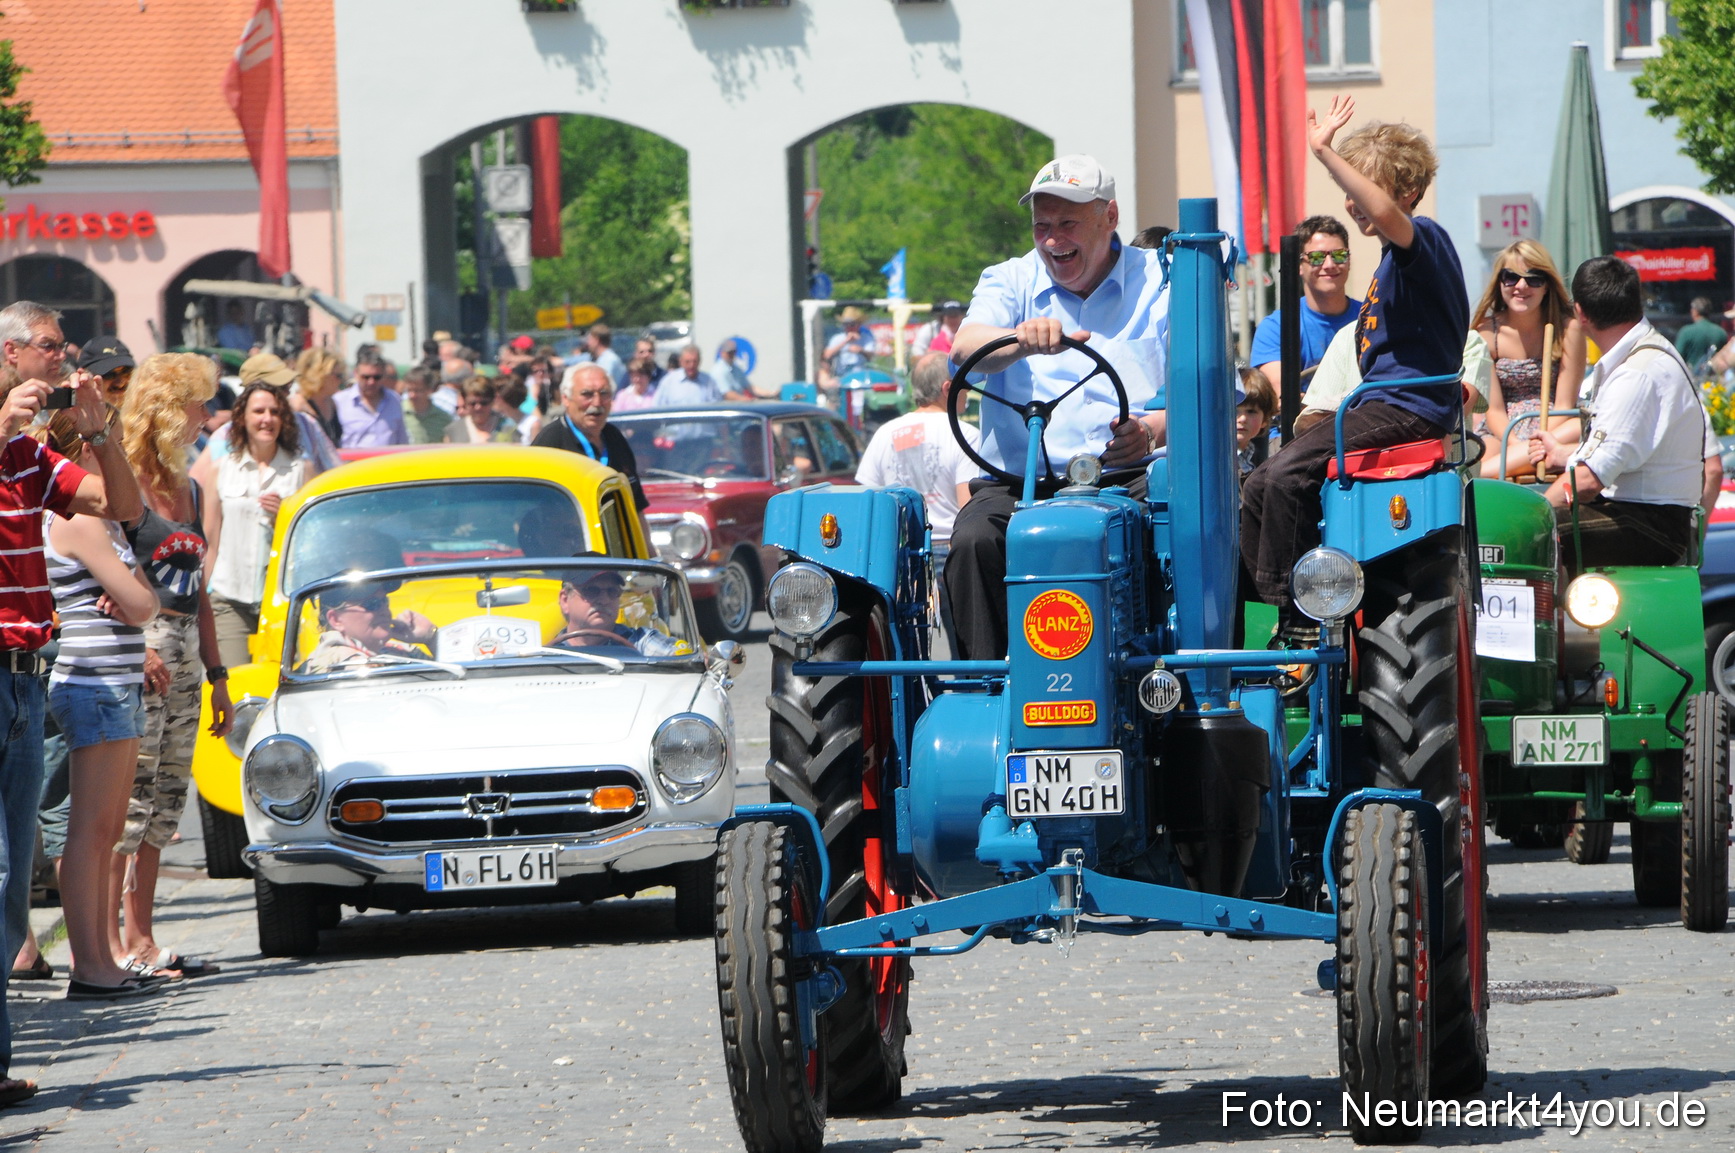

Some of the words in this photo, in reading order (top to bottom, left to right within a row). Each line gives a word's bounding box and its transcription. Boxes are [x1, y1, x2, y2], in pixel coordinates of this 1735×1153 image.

[0, 204, 157, 239] rkasse
[1037, 616, 1080, 632] LANZ
[480, 626, 527, 645] 493
[1046, 673, 1073, 692] 22
[1029, 705, 1089, 721] BULLDOG
[1541, 720, 1577, 741] NM
[1521, 742, 1556, 762] AN
[1563, 741, 1599, 762] 271
[1035, 757, 1072, 783] NM
[1014, 787, 1050, 813] GN
[442, 856, 459, 885] N
[478, 854, 513, 883] FL
